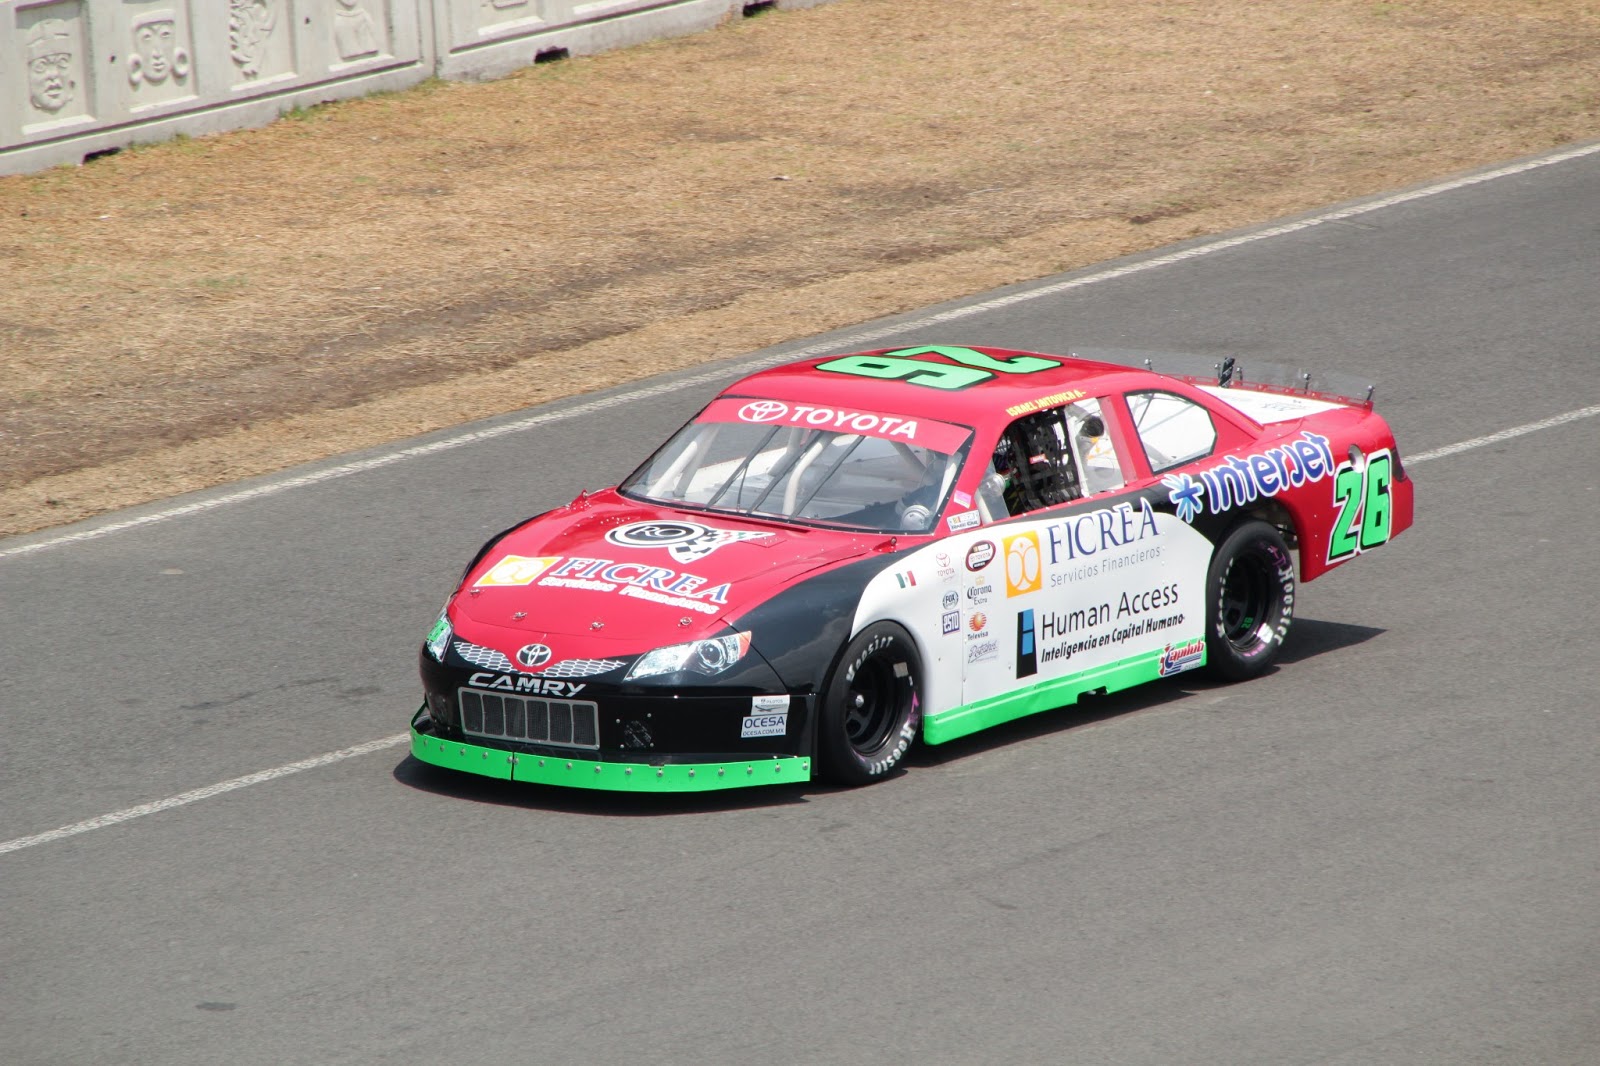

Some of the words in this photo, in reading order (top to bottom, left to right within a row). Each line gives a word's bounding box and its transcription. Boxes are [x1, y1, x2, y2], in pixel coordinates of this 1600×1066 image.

[813, 344, 1063, 390] 26
[792, 404, 918, 439] TOYOTA
[1005, 401, 1038, 417] ISRAEL
[1327, 450, 1391, 564] 26
[1046, 502, 1160, 565] FICREA
[549, 557, 731, 604] FICREA
[937, 567, 955, 577] TOYOTA
[1050, 565, 1099, 587] Servicios
[1102, 546, 1161, 573] Financieros
[945, 593, 956, 604] FOX
[967, 584, 992, 600] Corona
[974, 597, 988, 605] Extra
[1273, 564, 1294, 646] Hoosier
[1041, 603, 1110, 640] Human
[1116, 583, 1179, 620] Access
[967, 631, 989, 641] Televisa
[1041, 636, 1097, 663] Inteligencia
[1098, 633, 1110, 645] en
[1111, 619, 1145, 644] Capital
[1145, 613, 1184, 633] Humano
[468, 672, 586, 698] CAMRY
[742, 728, 785, 737] OCESA.COM.MX
[744, 716, 785, 729] OCESA
